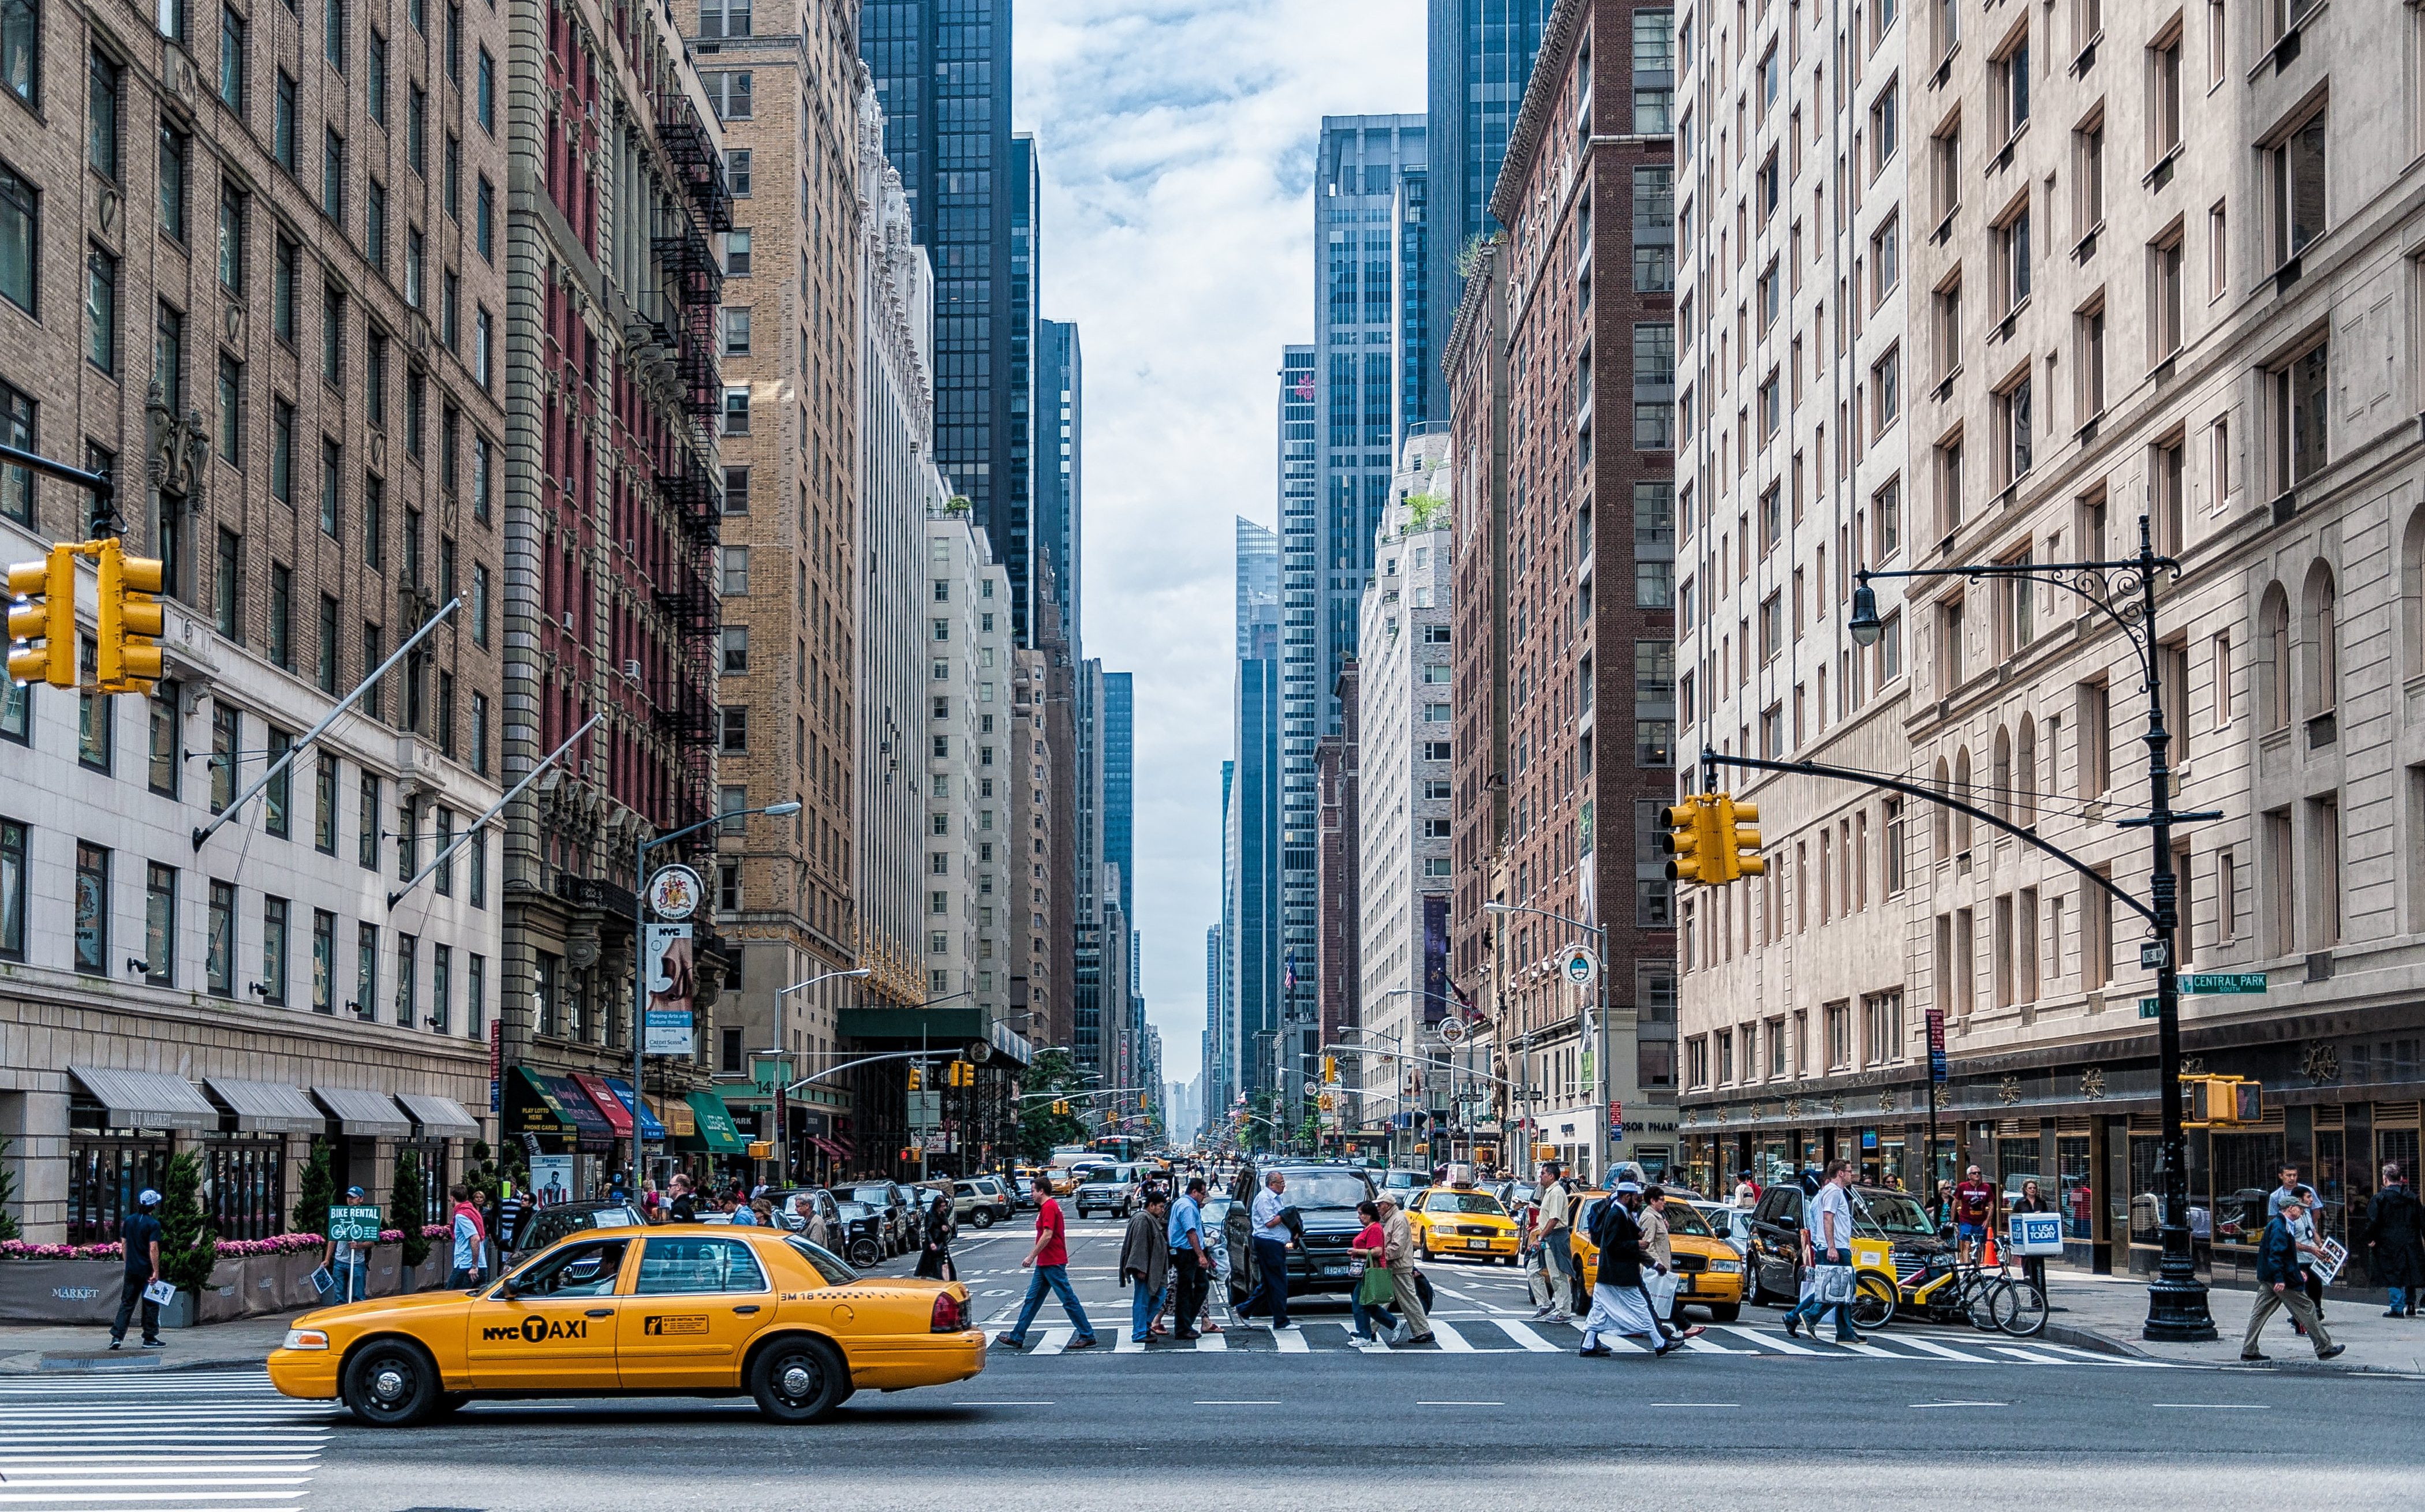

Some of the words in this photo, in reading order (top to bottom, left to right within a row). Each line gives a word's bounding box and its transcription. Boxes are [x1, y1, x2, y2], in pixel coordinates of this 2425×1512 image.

[660, 910, 690, 918] BARBADOS
[659, 928, 681, 936] NYC
[2194, 976, 2237, 986] CENTRAL
[2240, 975, 2265, 986] PARK
[2149, 1001, 2154, 1015] 6
[130, 1111, 142, 1125] BLT
[143, 1113, 171, 1126] MARKET
[331, 1208, 348, 1219] BIKE
[350, 1208, 378, 1219] RENTAL
[2030, 1231, 2056, 1239] TODAY
[52, 1288, 99, 1298] MARKET
[483, 1327, 520, 1340] NYC
[524, 1318, 587, 1340] TAXI
